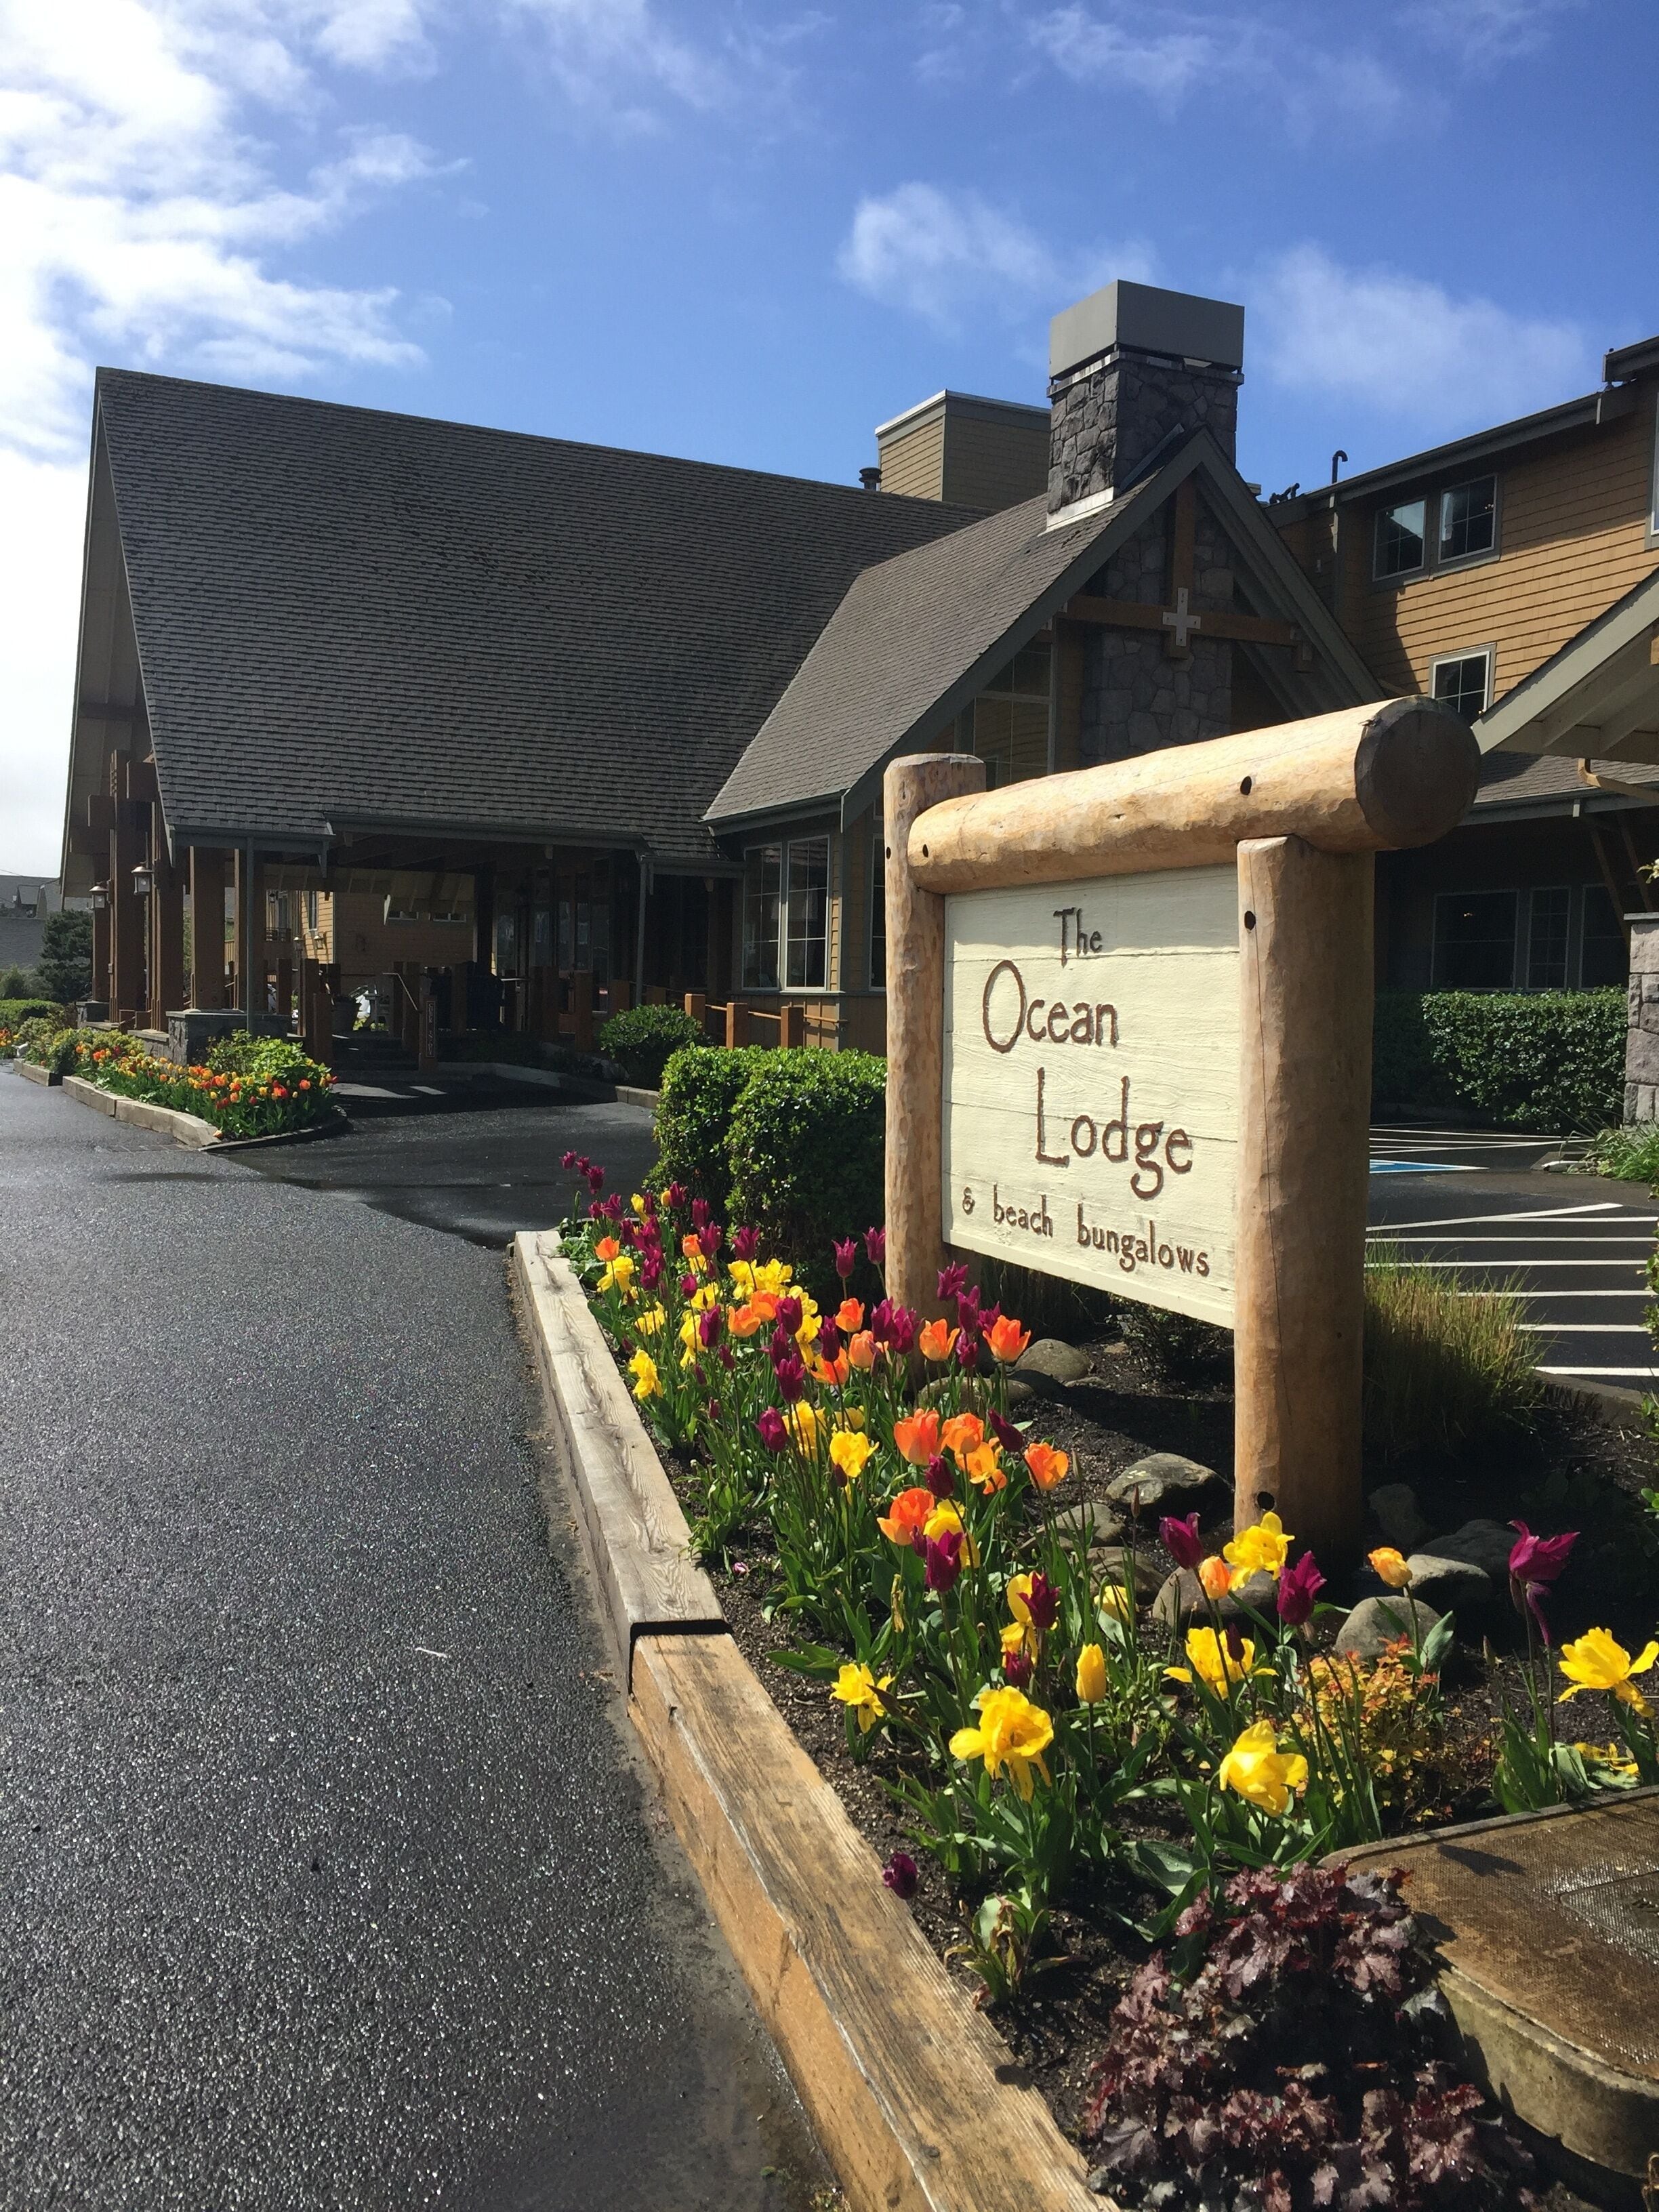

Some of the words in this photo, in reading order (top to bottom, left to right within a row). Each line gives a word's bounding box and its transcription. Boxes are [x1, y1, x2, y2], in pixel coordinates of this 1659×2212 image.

[1053, 907, 1103, 968] The
[983, 960, 1119, 1053] Ocean
[1036, 1067, 1193, 1200] Lodge
[962, 1187, 976, 1215] &
[994, 1184, 1054, 1237] beach
[1078, 1203, 1210, 1277] bungalows
